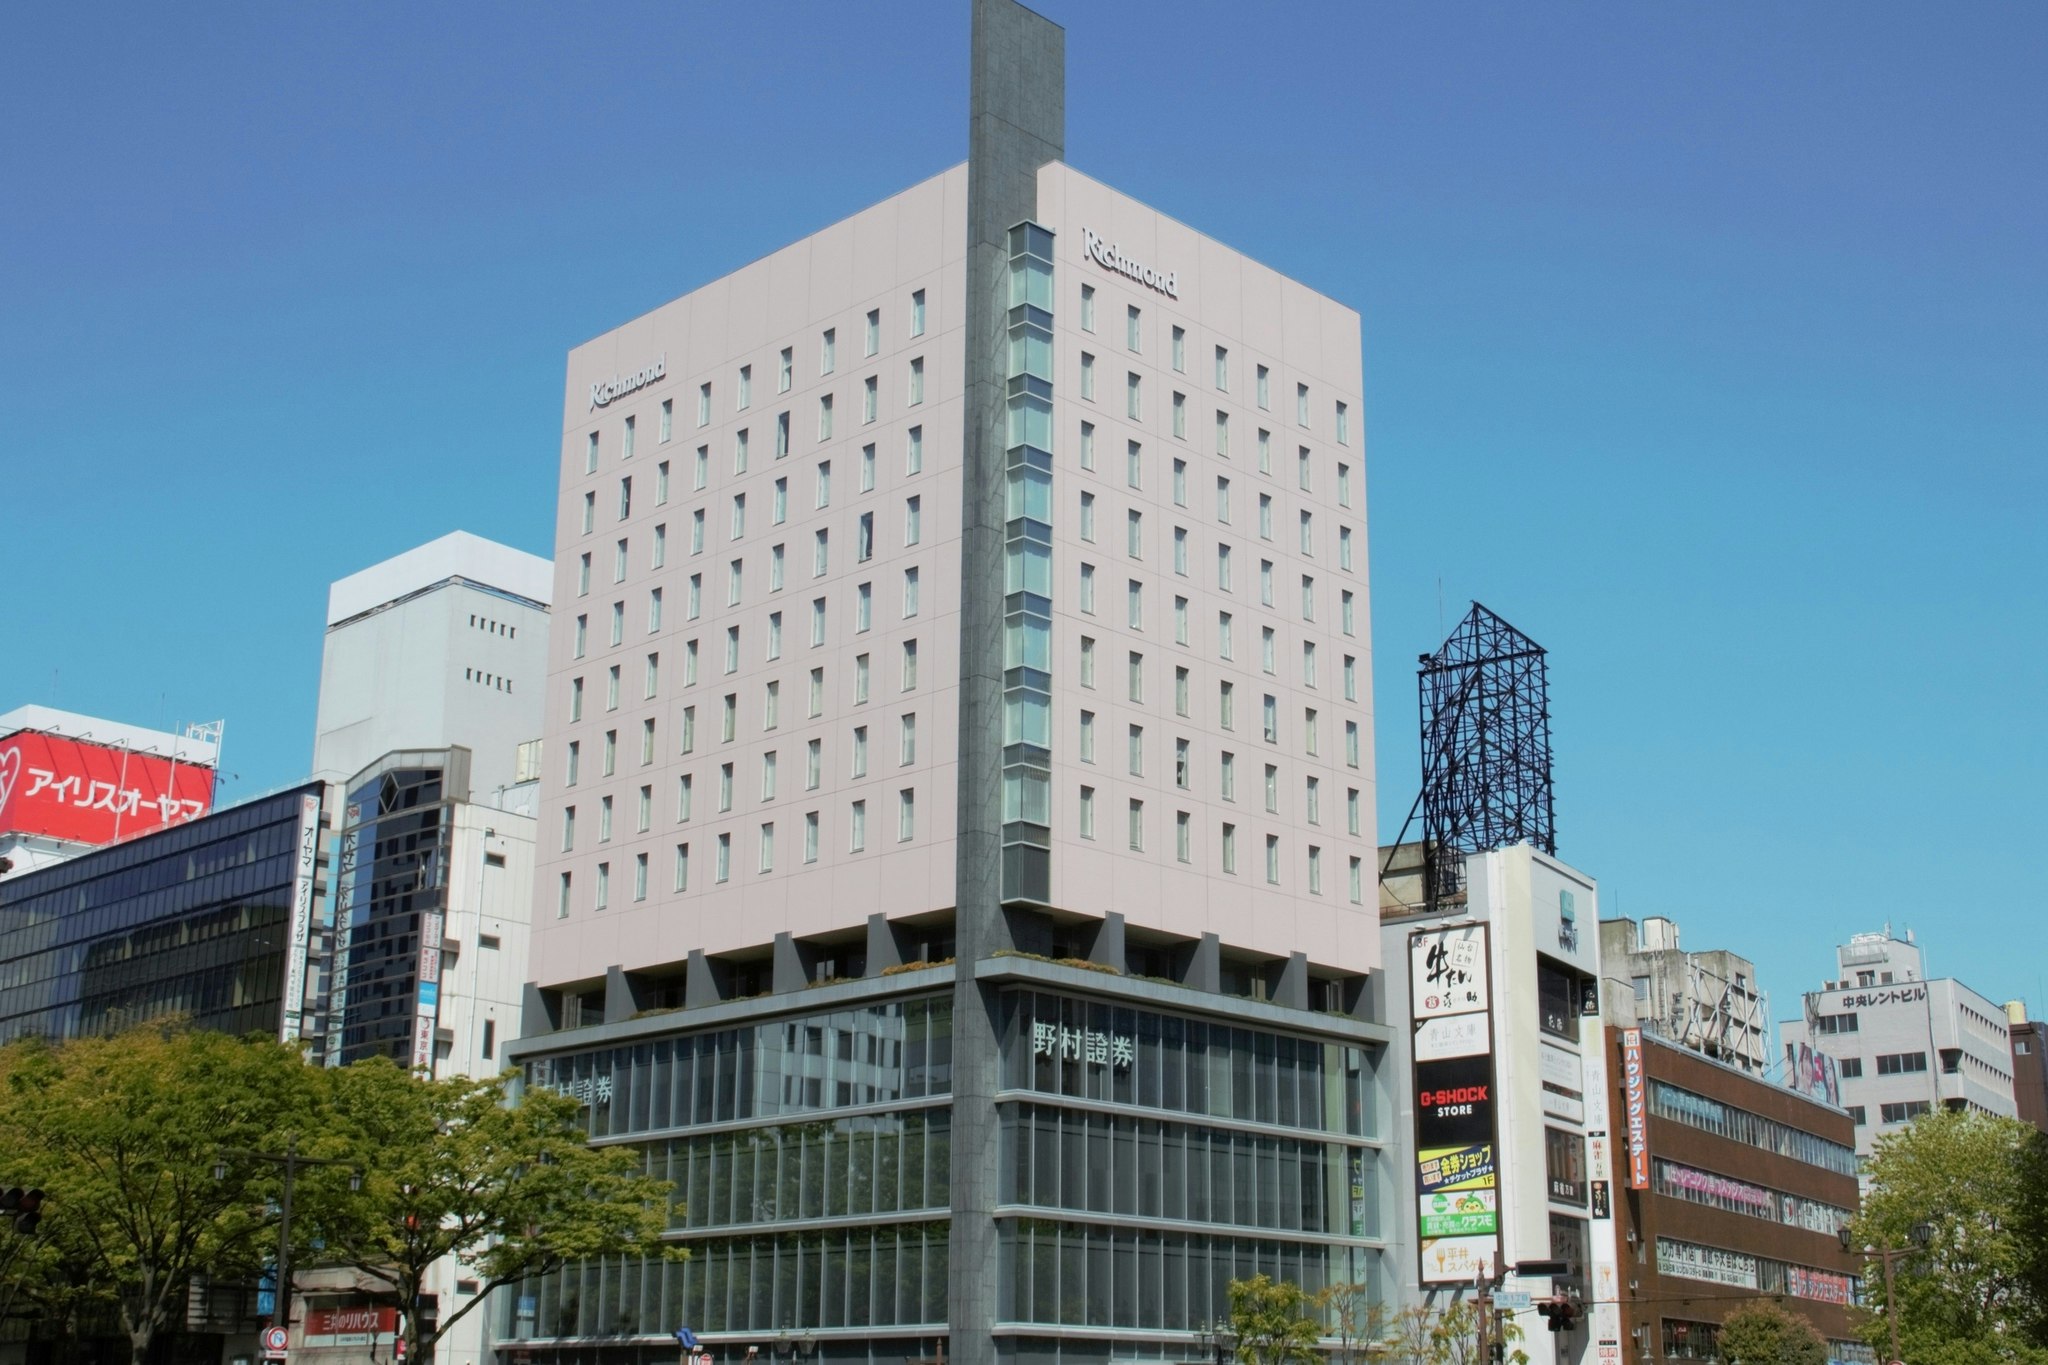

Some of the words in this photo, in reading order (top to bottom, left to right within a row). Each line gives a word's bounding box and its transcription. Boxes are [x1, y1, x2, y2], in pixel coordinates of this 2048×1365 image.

[1082, 226, 1178, 299] Richmond
[589, 352, 667, 413] Richmond
[25, 768, 204, 825] アイリスオーヤマ
[1843, 988, 1925, 1009] 中央レントビル
[1034, 1022, 1133, 1067] 野村證券
[541, 1076, 612, 1105] 村證券
[1421, 1086, 1488, 1106] G-SHOCK
[1437, 1105, 1473, 1117] STORE
[1627, 1049, 1647, 1185] ハウジングエステート
[1441, 1145, 1491, 1177] 金券ショップ
[1482, 1175, 1494, 1186] 1F
[1461, 1215, 1493, 1228] クラスモ
[1447, 1248, 1469, 1260] 平井
[323, 1312, 379, 1331] 三井のリハウス
